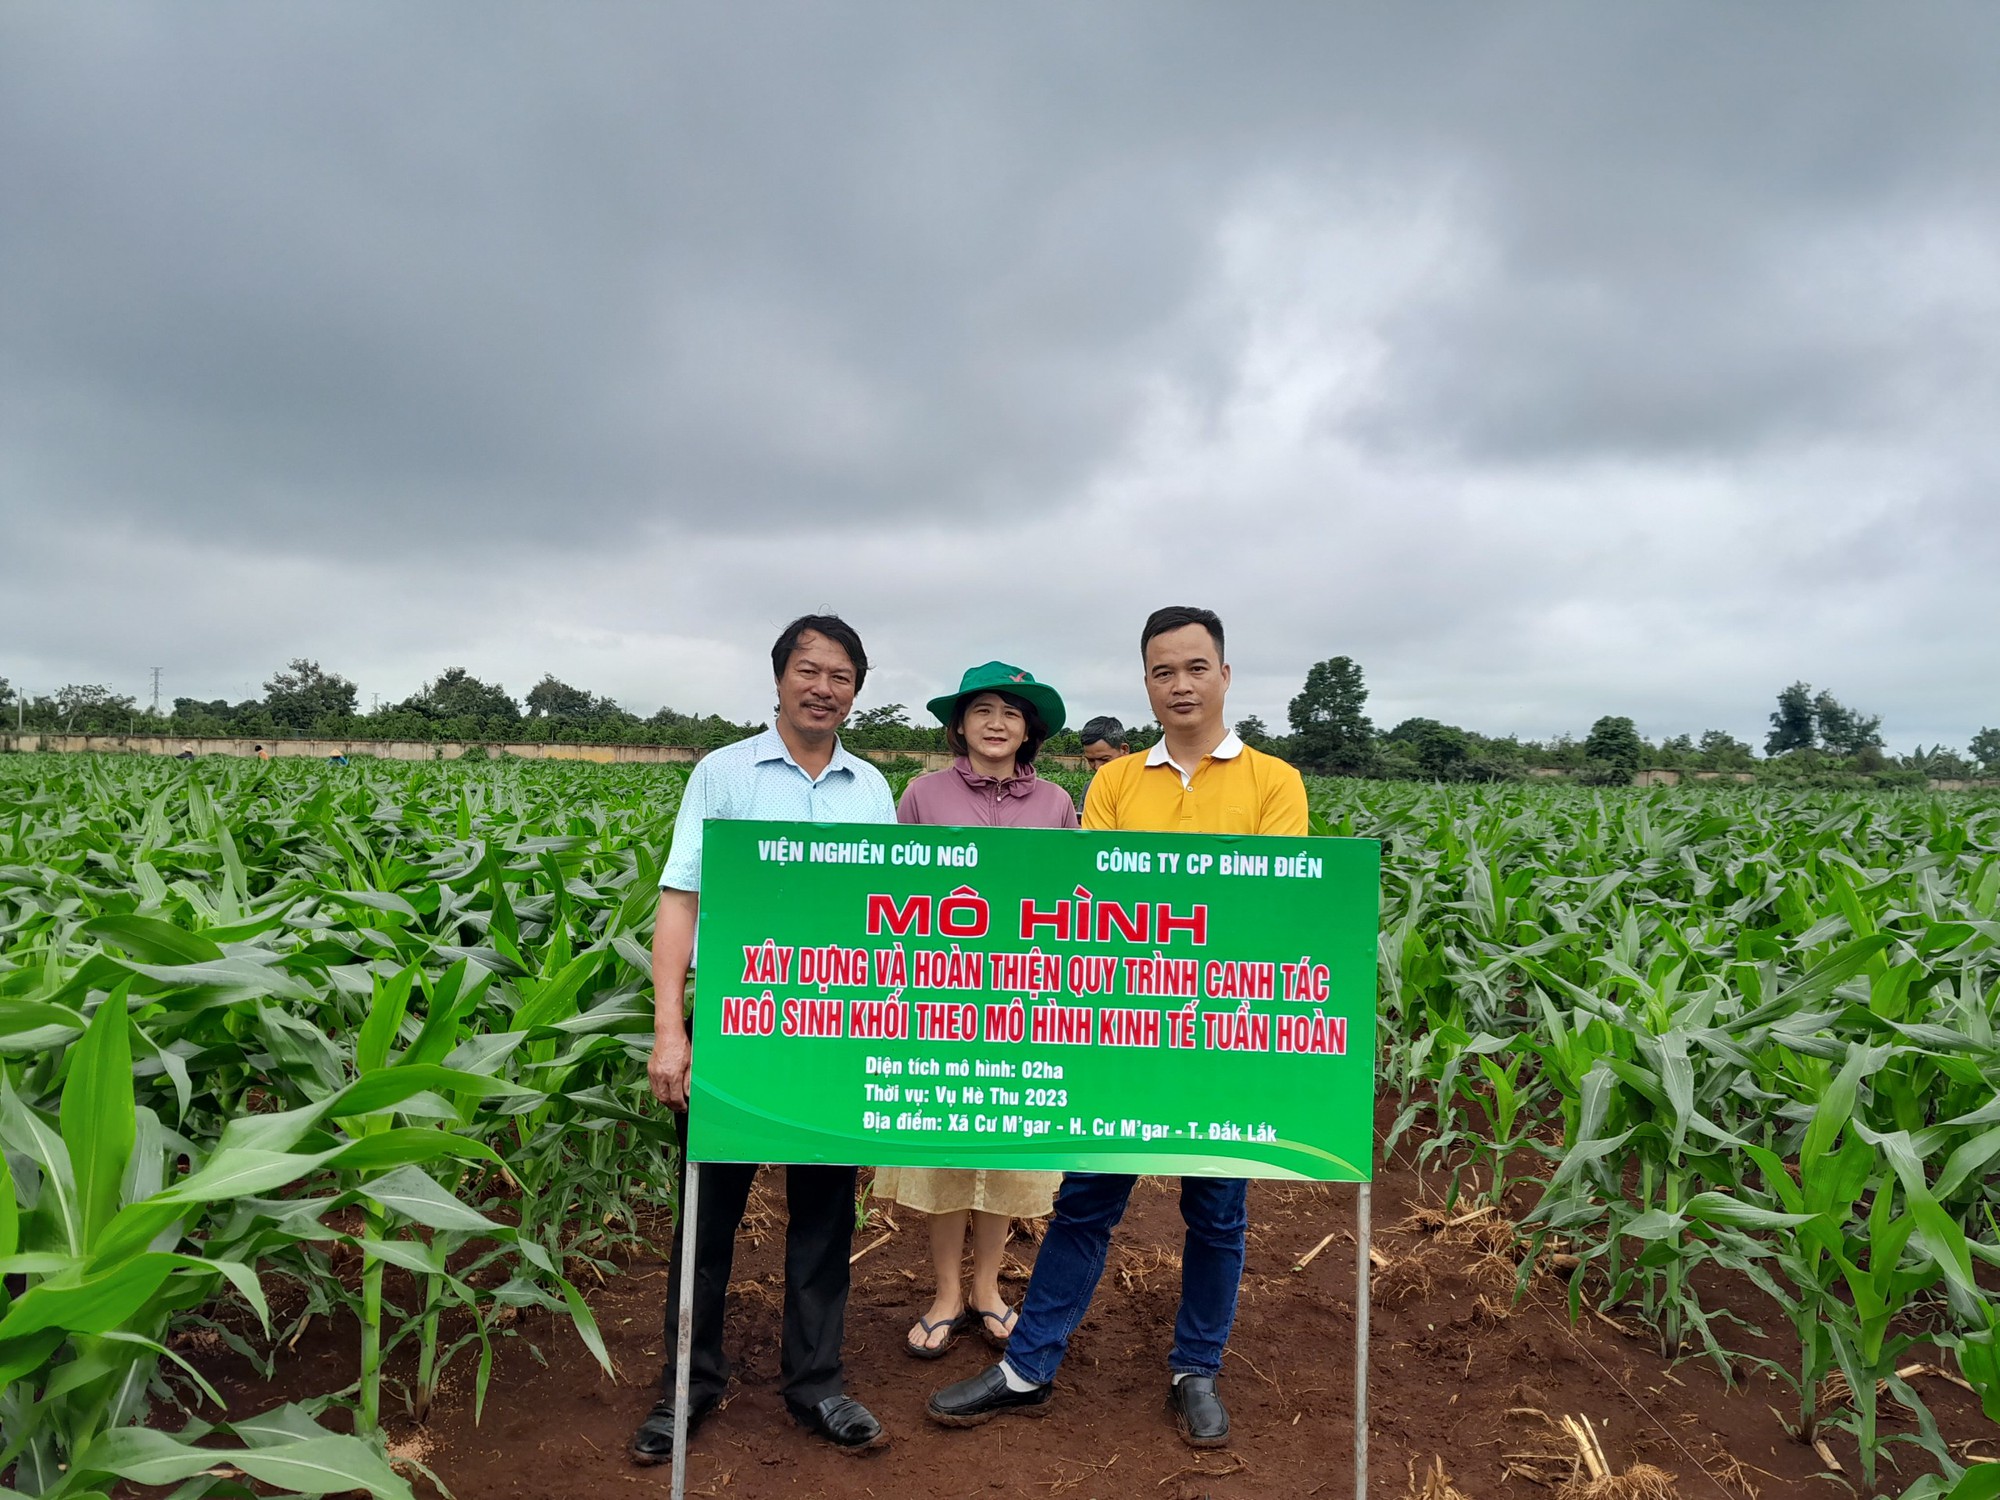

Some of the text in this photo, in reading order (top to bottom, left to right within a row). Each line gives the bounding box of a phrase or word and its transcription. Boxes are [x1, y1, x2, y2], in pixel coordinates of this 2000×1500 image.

[758, 837, 978, 867] VIỆN NGHIÊN CỨU NGÔ
[1096, 847, 1323, 878] CÔNG TY CP BÌNH ĐIỀN
[866, 884, 1208, 945] MÔ HÌNH
[741, 938, 1330, 1003] XÂY DỰNG VÀ HOÀN THIỆN QUY TRÌNH CANH TÁC
[721, 988, 1347, 1055] NGÔ SINH KHỐI THEO MÔ HÌNH KINH TẾ TUẦN HOÀN
[865, 1056, 1064, 1079] Diện tích mô hình: 02ha
[864, 1083, 1068, 1108] Thời vụ: Vụ Hè Thu 2023
[863, 1112, 895, 1133] Địa
[897, 1109, 942, 1131] điểm:
[948, 1113, 969, 1132] Xã
[975, 1115, 997, 1132] Cư
[1070, 1117, 1086, 1136] H.
[1093, 1118, 1116, 1137] Cư
[1188, 1121, 1203, 1140] T.
[1208, 1120, 1241, 1141] Đắk
[1247, 1120, 1277, 1143] Lắk
